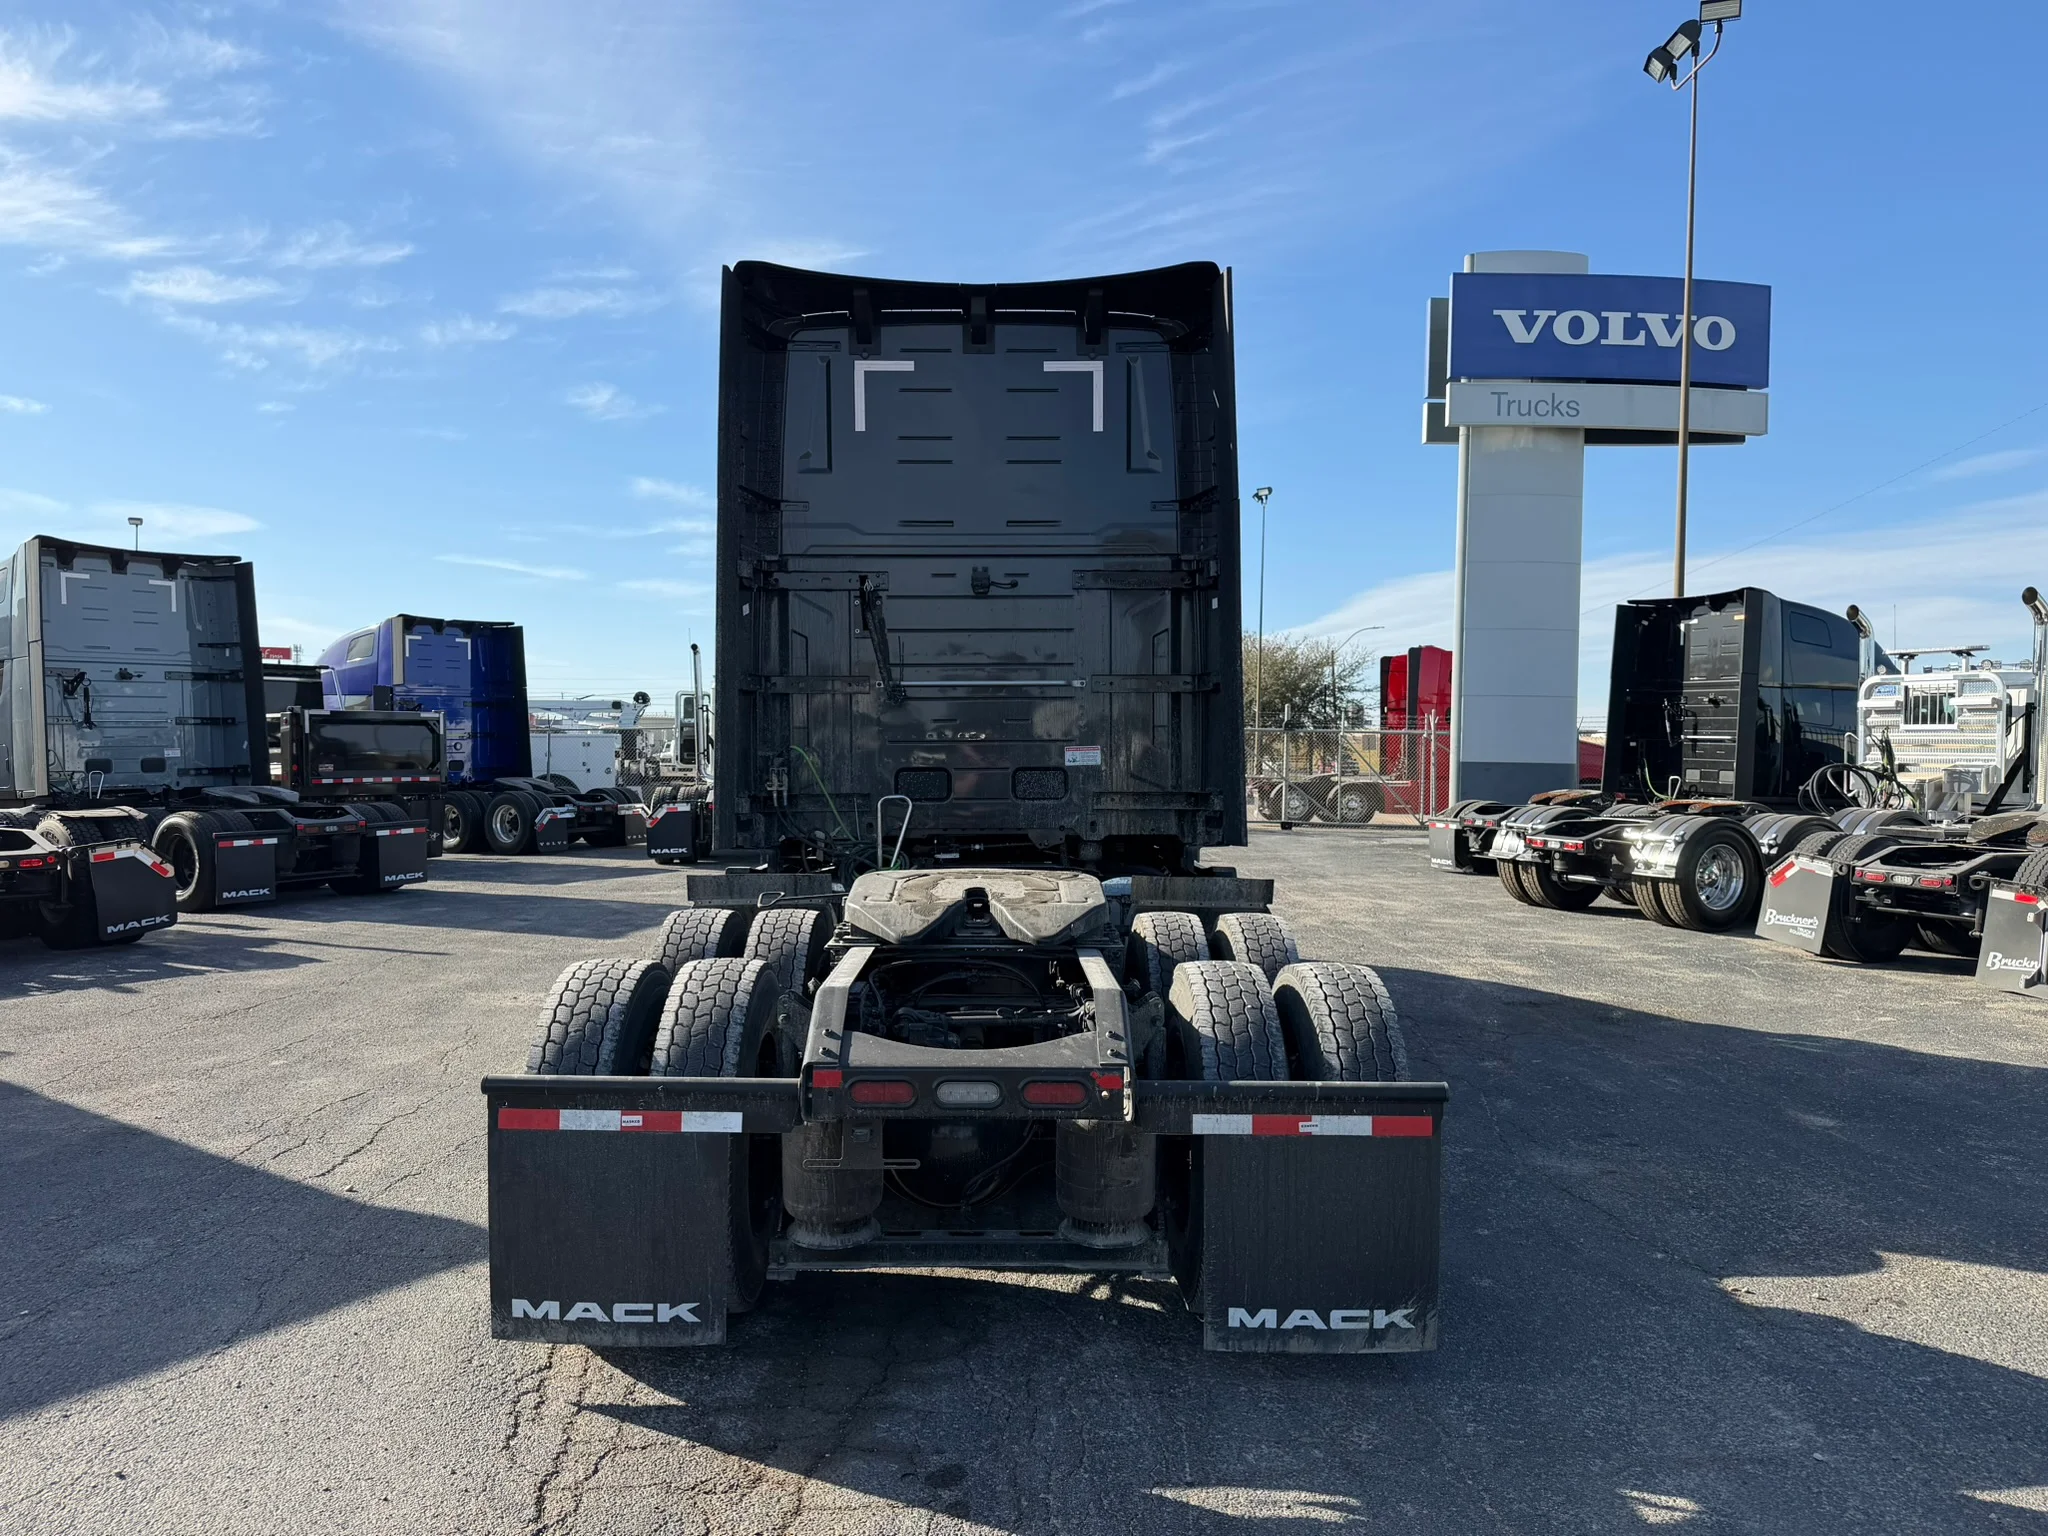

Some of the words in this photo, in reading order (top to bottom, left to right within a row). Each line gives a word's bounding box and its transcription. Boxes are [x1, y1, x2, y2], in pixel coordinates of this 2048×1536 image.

[1493, 309, 1736, 351] VOLVO
[1490, 391, 1580, 418] Trucks
[384, 871, 424, 882] MACK
[222, 887, 270, 899] MACK
[107, 913, 171, 934] MACK
[512, 1298, 701, 1323] MACK
[1228, 1307, 1415, 1330] MACK
